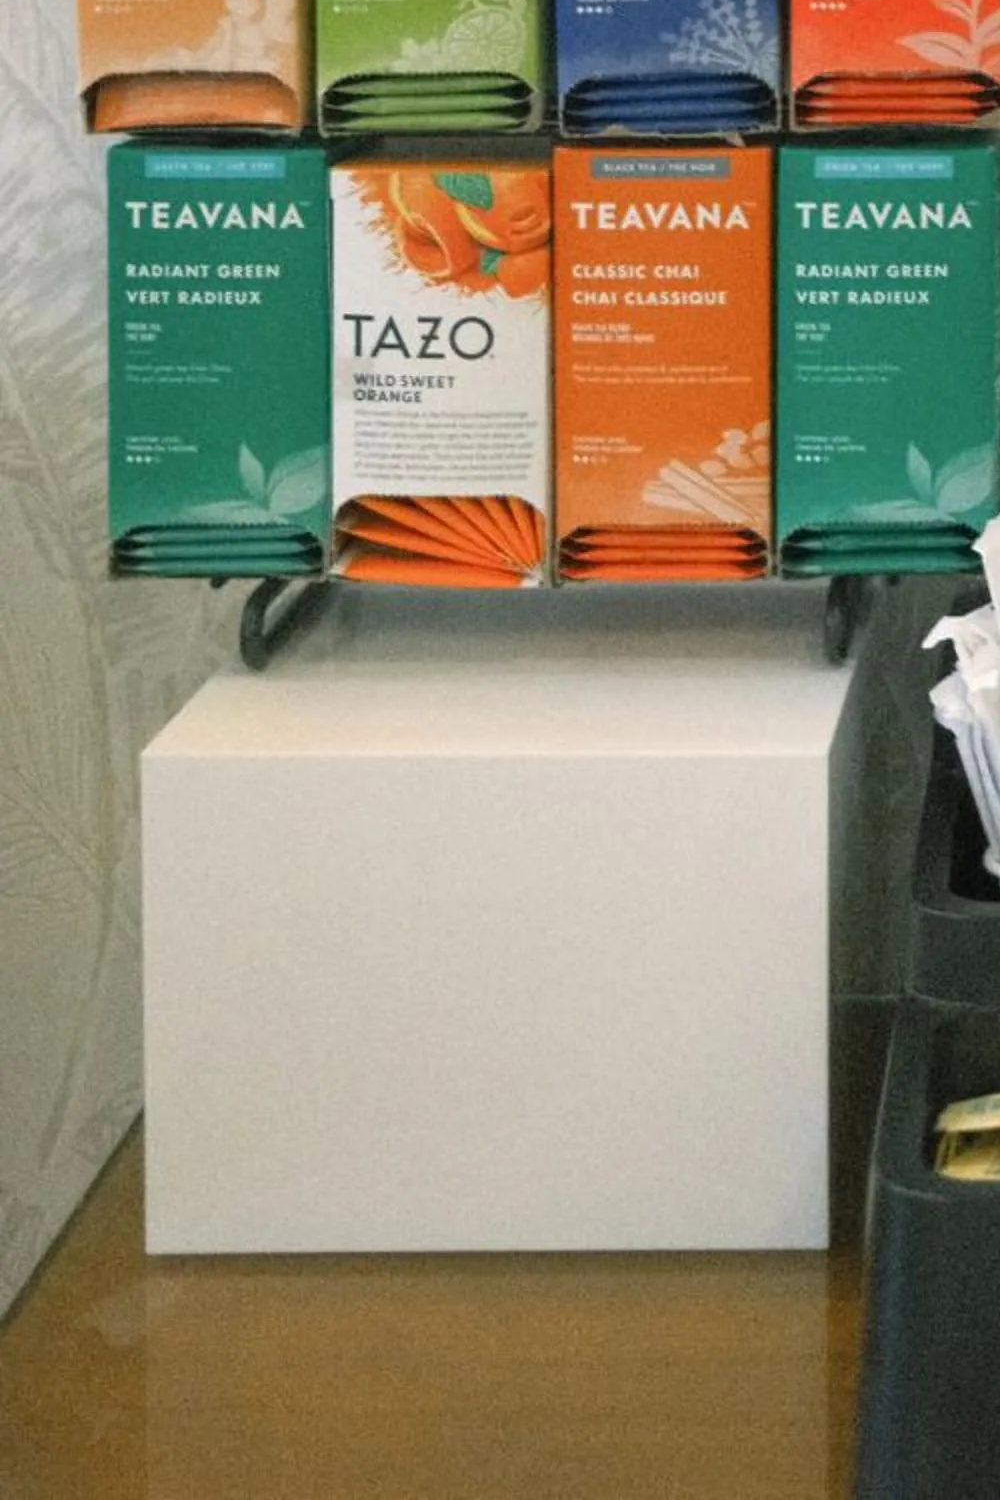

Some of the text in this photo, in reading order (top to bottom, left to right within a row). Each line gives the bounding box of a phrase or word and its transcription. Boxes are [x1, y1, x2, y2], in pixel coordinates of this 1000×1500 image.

[125, 202, 305, 229] TEAVANA
[570, 203, 750, 230] TEAVANA
[795, 202, 973, 229] TEAVANA
[125, 264, 280, 278] RADIANT GREEN
[572, 264, 700, 278] CLASSIC CHAI
[795, 264, 948, 278] RADIANT GREEN
[125, 291, 261, 305] VERT RADIEUX
[572, 291, 727, 305] CHAI CLASSIQUE
[795, 291, 929, 305] VERT RADIEUX
[343, 314, 494, 360] TAZO
[353, 373, 455, 389] WILD SWEET
[353, 389, 422, 404] ORANGE
